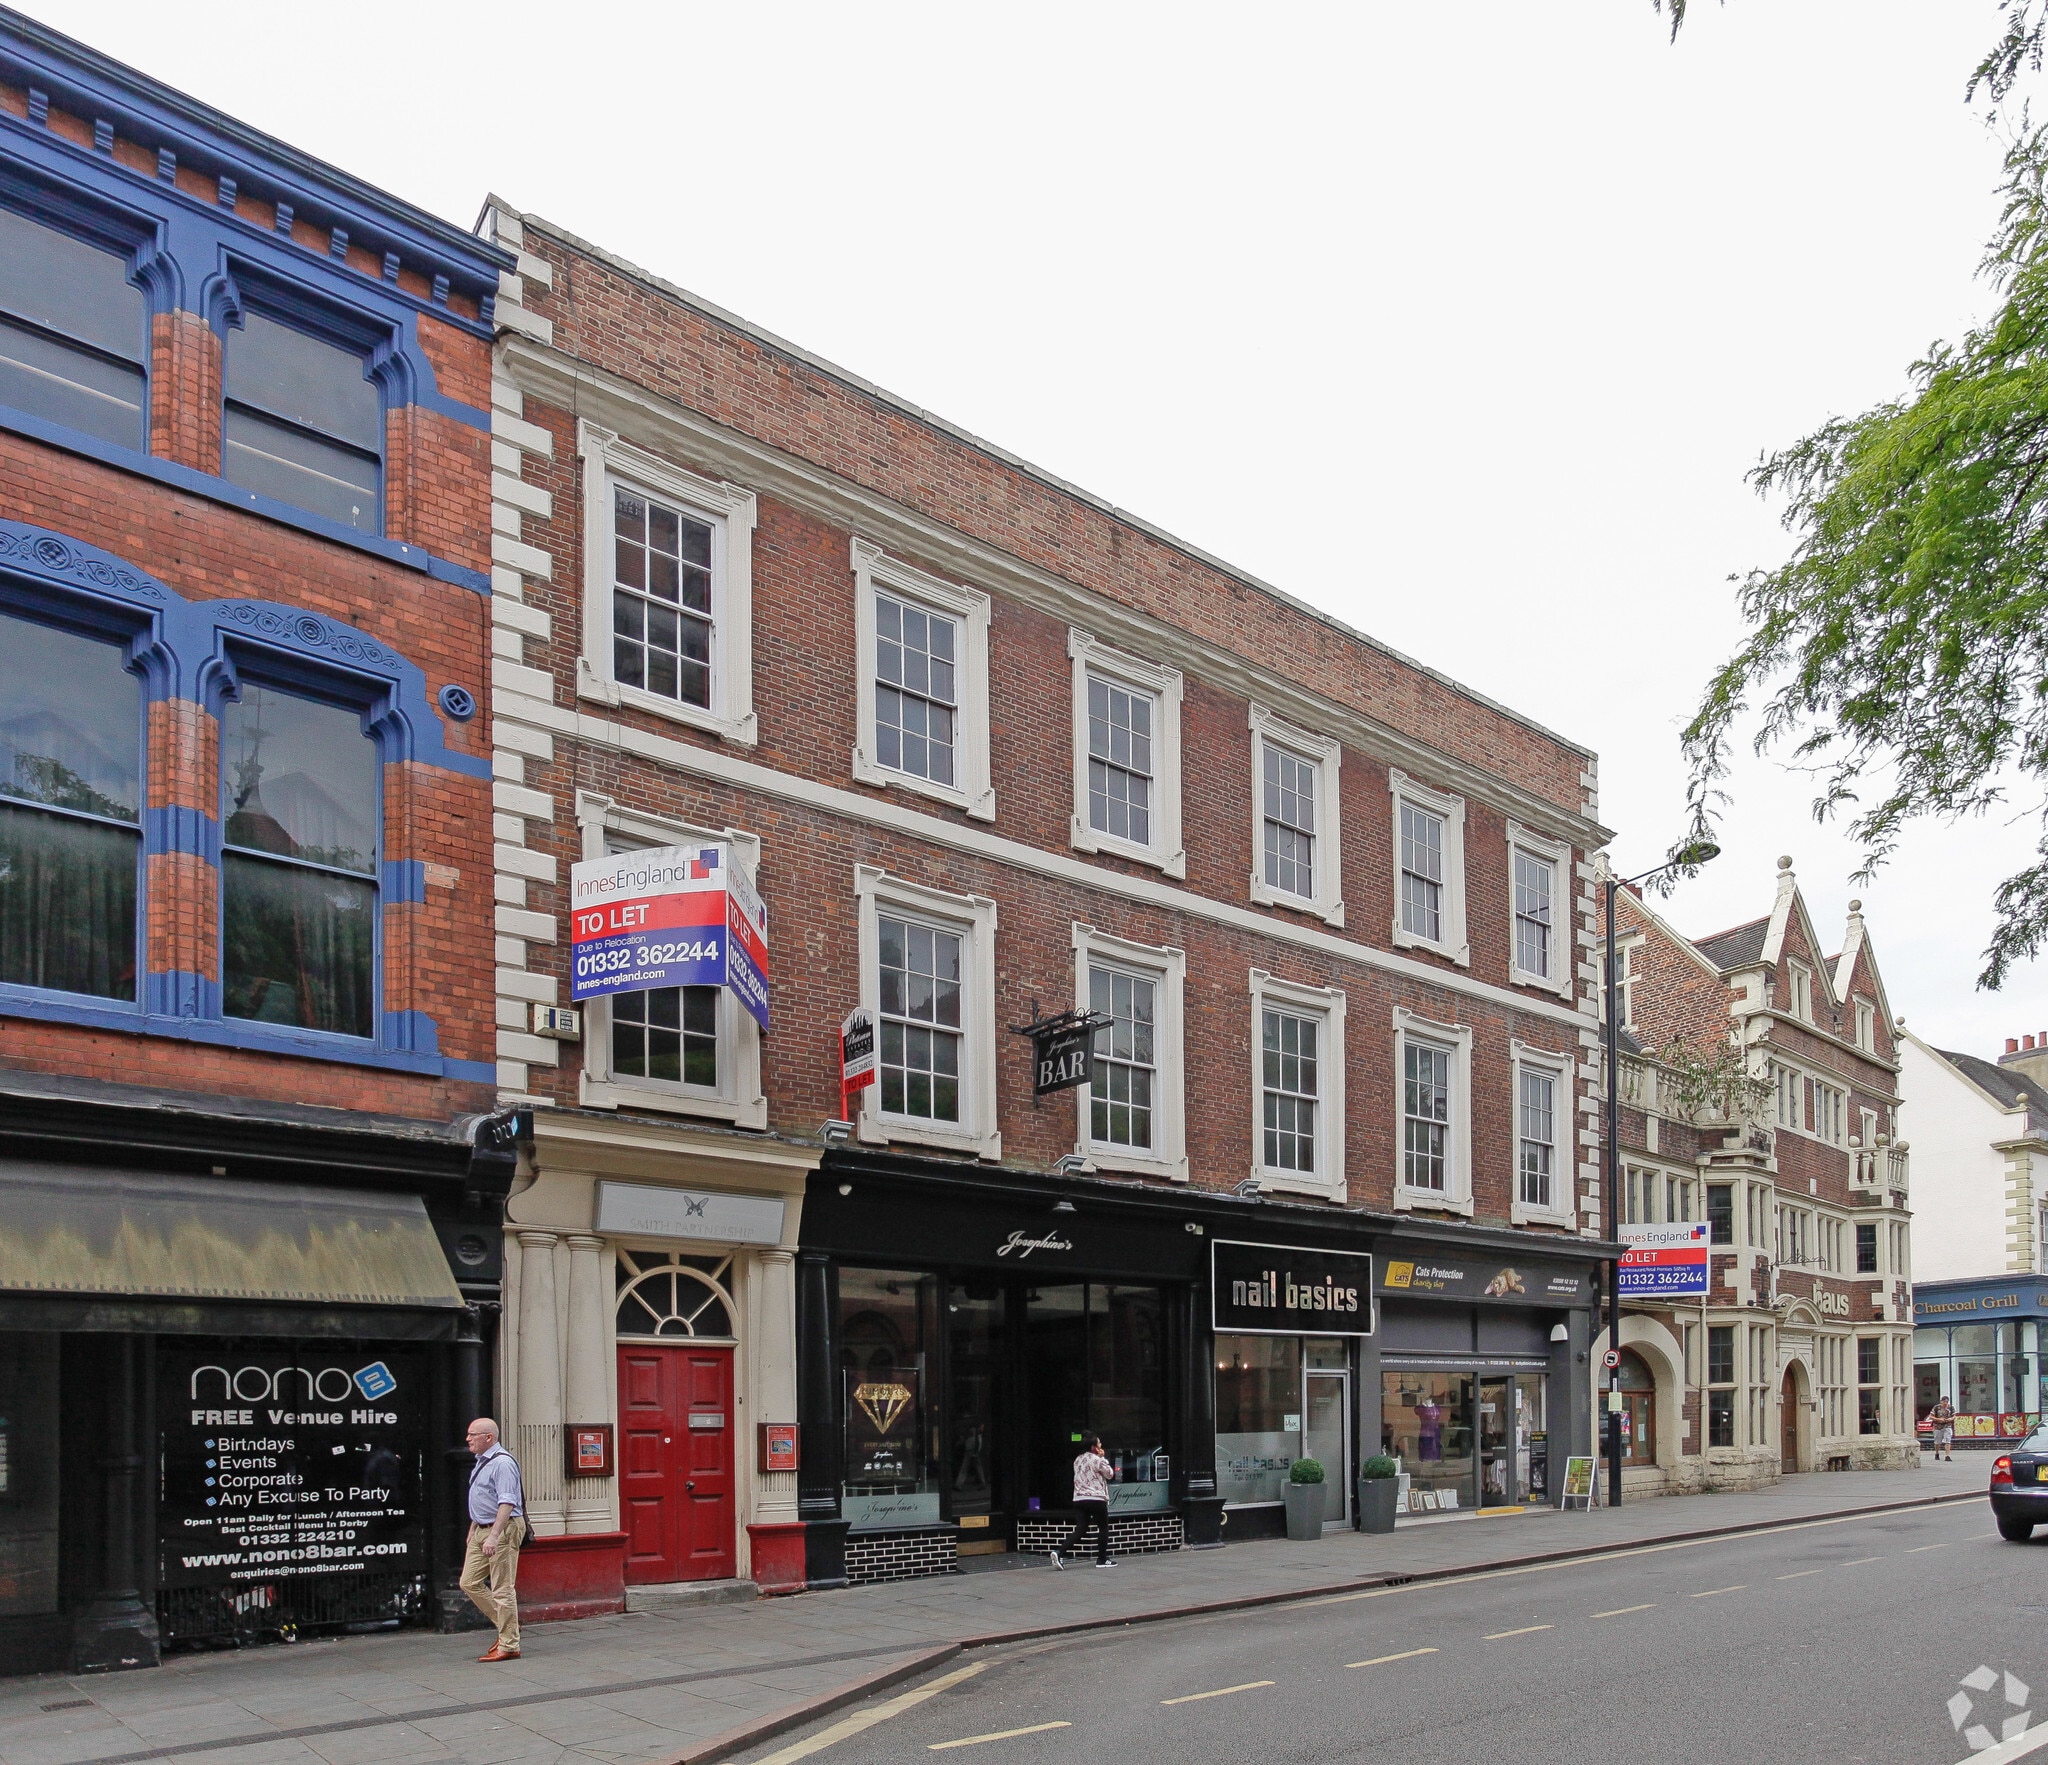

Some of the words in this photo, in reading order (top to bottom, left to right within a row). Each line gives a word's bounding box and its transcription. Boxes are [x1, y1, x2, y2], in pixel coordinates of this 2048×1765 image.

[577, 861, 685, 897] InnesEngland
[577, 912, 604, 936] TO
[610, 903, 650, 929] LET
[729, 901, 740, 931] TO
[740, 915, 751, 947] LET
[578, 944, 593, 954] Due
[595, 942, 603, 951] to
[604, 934, 647, 949] Relocation
[577, 948, 631, 976] 01332
[636, 940, 719, 966] 362244
[577, 969, 665, 990] innes-england.com
[1038, 1051, 1085, 1087] BAR
[847, 1079, 857, 1091] TO
[858, 1072, 872, 1087] LET
[630, 1217, 670, 1231] SMITH
[674, 1221, 755, 1239] PARTNERSHIP
[1618, 1231, 1689, 1243] InnesEngland
[996, 1230, 1073, 1258] Josephine's
[1636, 1252, 1658, 1263] LET
[1415, 1266, 1430, 1277] Cats
[1431, 1268, 1464, 1279] Protection
[1619, 1274, 1655, 1285] 01332
[1657, 1271, 1703, 1284] 362244
[1232, 1271, 1277, 1307] nail
[1285, 1271, 1358, 1312] basics
[1812, 1283, 1850, 1316] haus
[1912, 1298, 1978, 1314] Charcoal
[1981, 1294, 2019, 1309] Grill
[191, 1409, 254, 1426] FREE
[268, 1409, 344, 1425] Venue
[351, 1409, 398, 1425] Hire
[217, 1437, 295, 1452] Birthdays
[219, 1456, 277, 1469] Events
[218, 1472, 304, 1489] Corporate
[219, 1491, 253, 1508] Any
[258, 1490, 320, 1504] Excuse
[324, 1488, 344, 1501] To
[349, 1486, 391, 1503] Party
[183, 1518, 212, 1527] Open
[216, 1516, 246, 1524] 11am
[248, 1515, 275, 1524] Daily
[277, 1513, 292, 1521] for
[295, 1512, 327, 1520] Lunch
[336, 1509, 384, 1518] Afternoon
[386, 1508, 405, 1516] Tea
[221, 1526, 246, 1534] Best
[248, 1522, 291, 1532] Cocktail
[294, 1521, 324, 1530] Menu
[326, 1520, 337, 1528] In
[339, 1519, 369, 1528] Derby
[239, 1533, 290, 1546] 01332
[294, 1530, 356, 1543] 224210
[182, 1542, 408, 1568] www.nono8bar.com
[230, 1562, 365, 1580] enquiries@nono8bar.com
